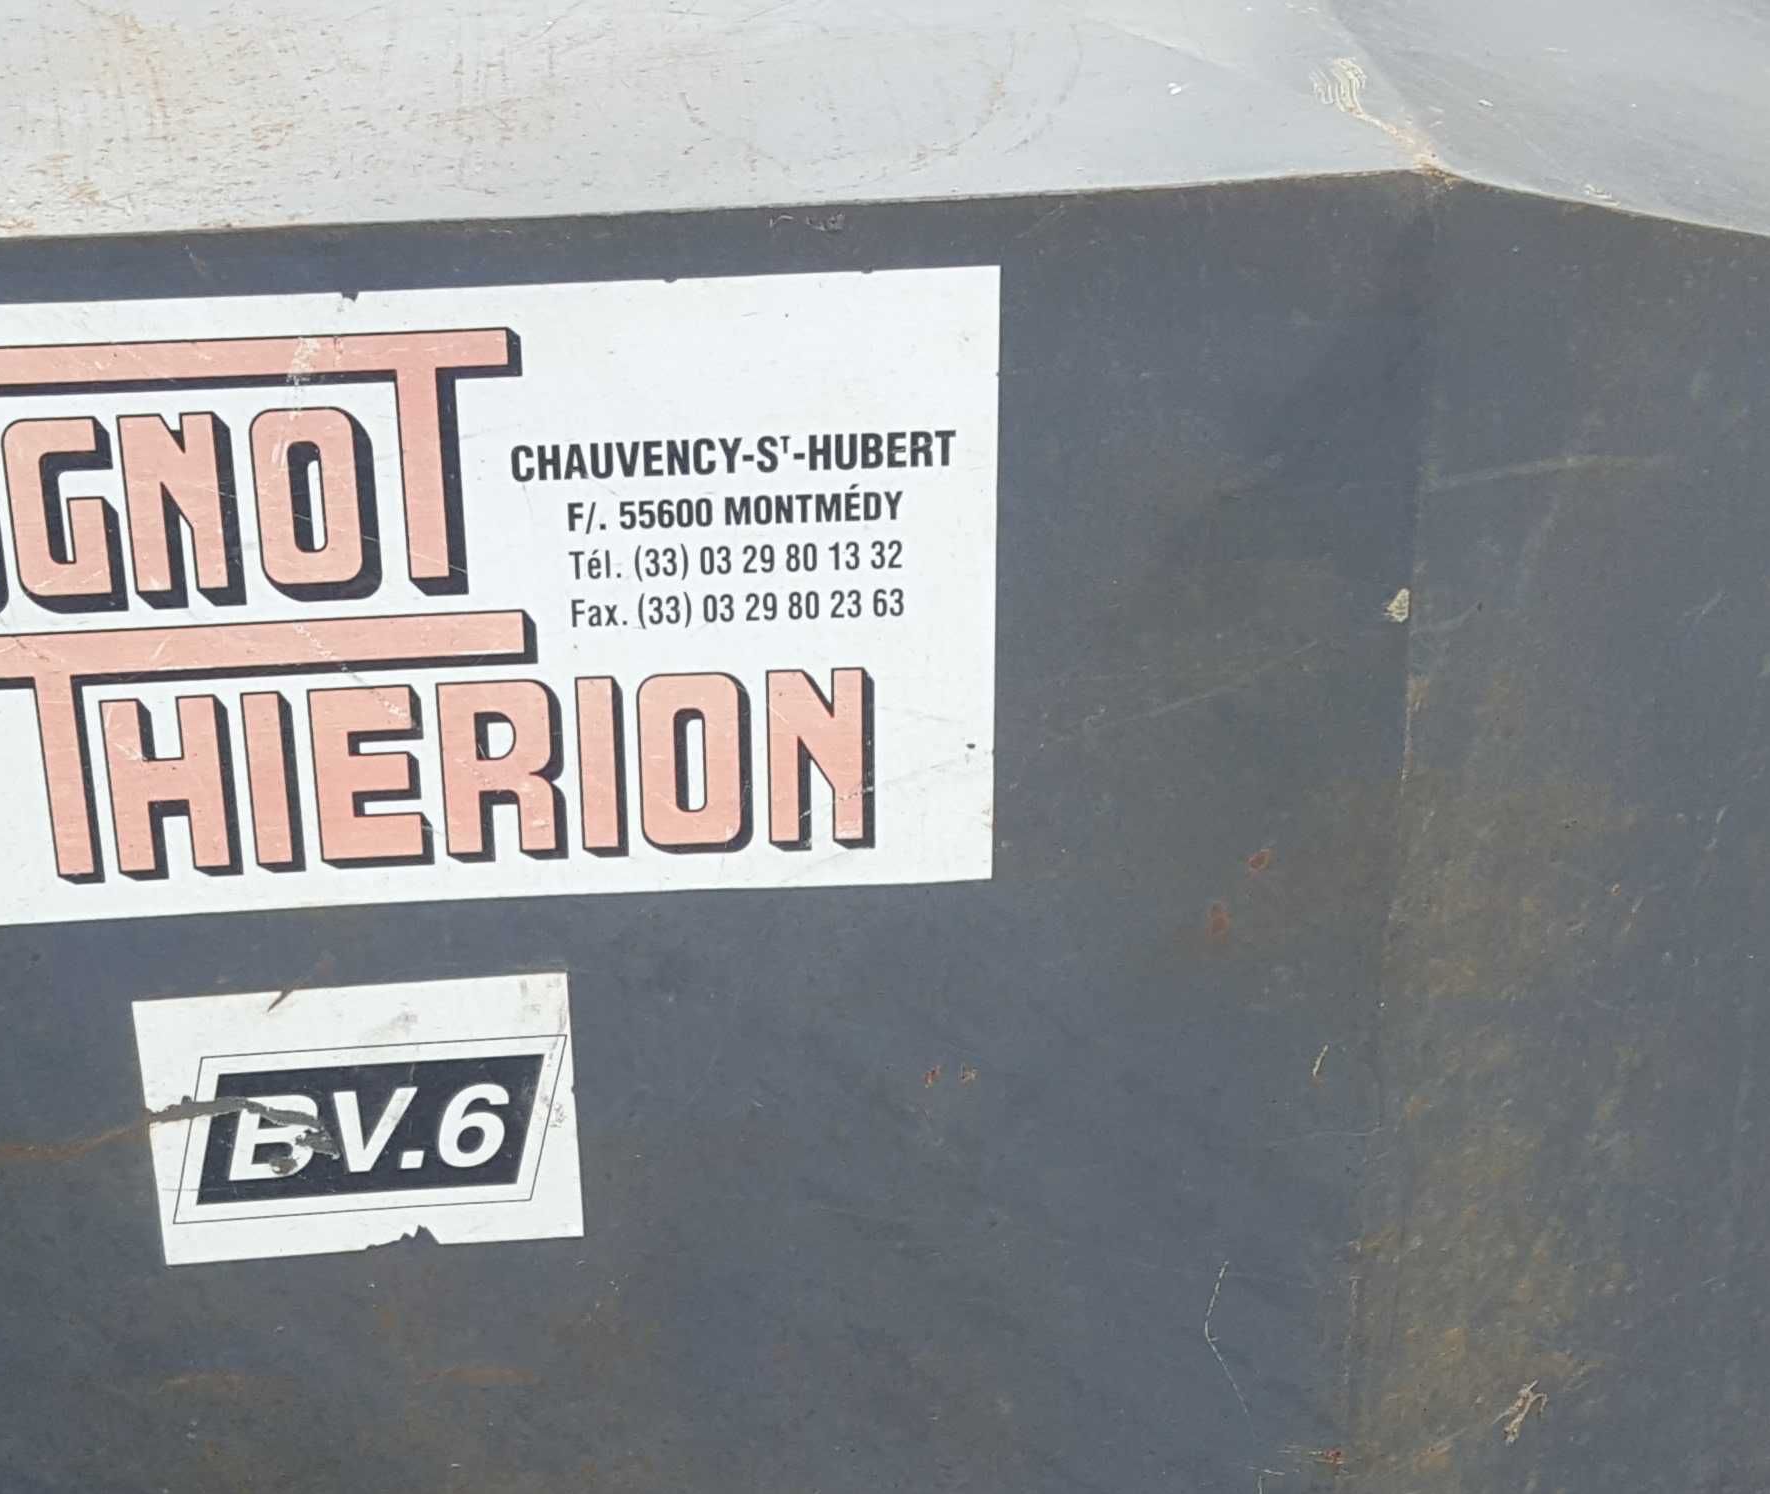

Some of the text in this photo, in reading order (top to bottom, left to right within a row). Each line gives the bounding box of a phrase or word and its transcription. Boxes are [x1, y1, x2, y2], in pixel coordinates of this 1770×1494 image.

[566, 483, 903, 535] F/. 55600 MONTMÉDY
[568, 539, 903, 582] Tél. (33) 03 29 80 13 32
[569, 588, 905, 630] Fax. (33) 03 29 80 23 63
[229, 1083, 510, 1182] BV.6
